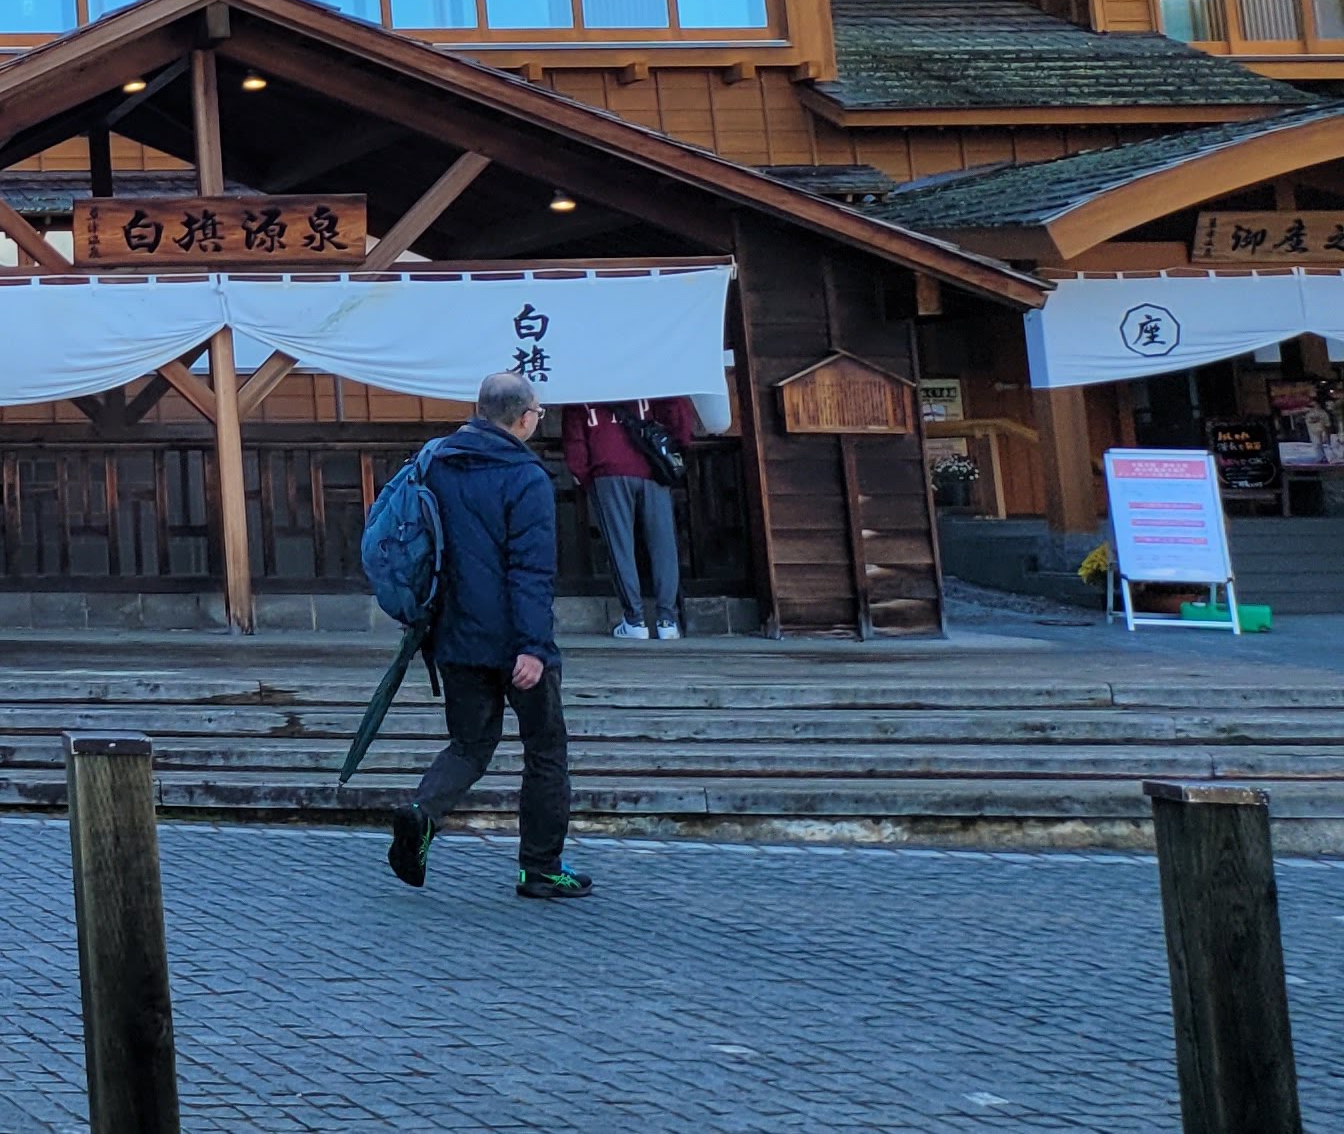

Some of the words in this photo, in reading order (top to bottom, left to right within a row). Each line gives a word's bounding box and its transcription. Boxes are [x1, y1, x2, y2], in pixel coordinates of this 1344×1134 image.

[122, 204, 349, 254] 白旗源泉
[505, 303, 552, 383] 白旗
[1132, 313, 1167, 347] 座
